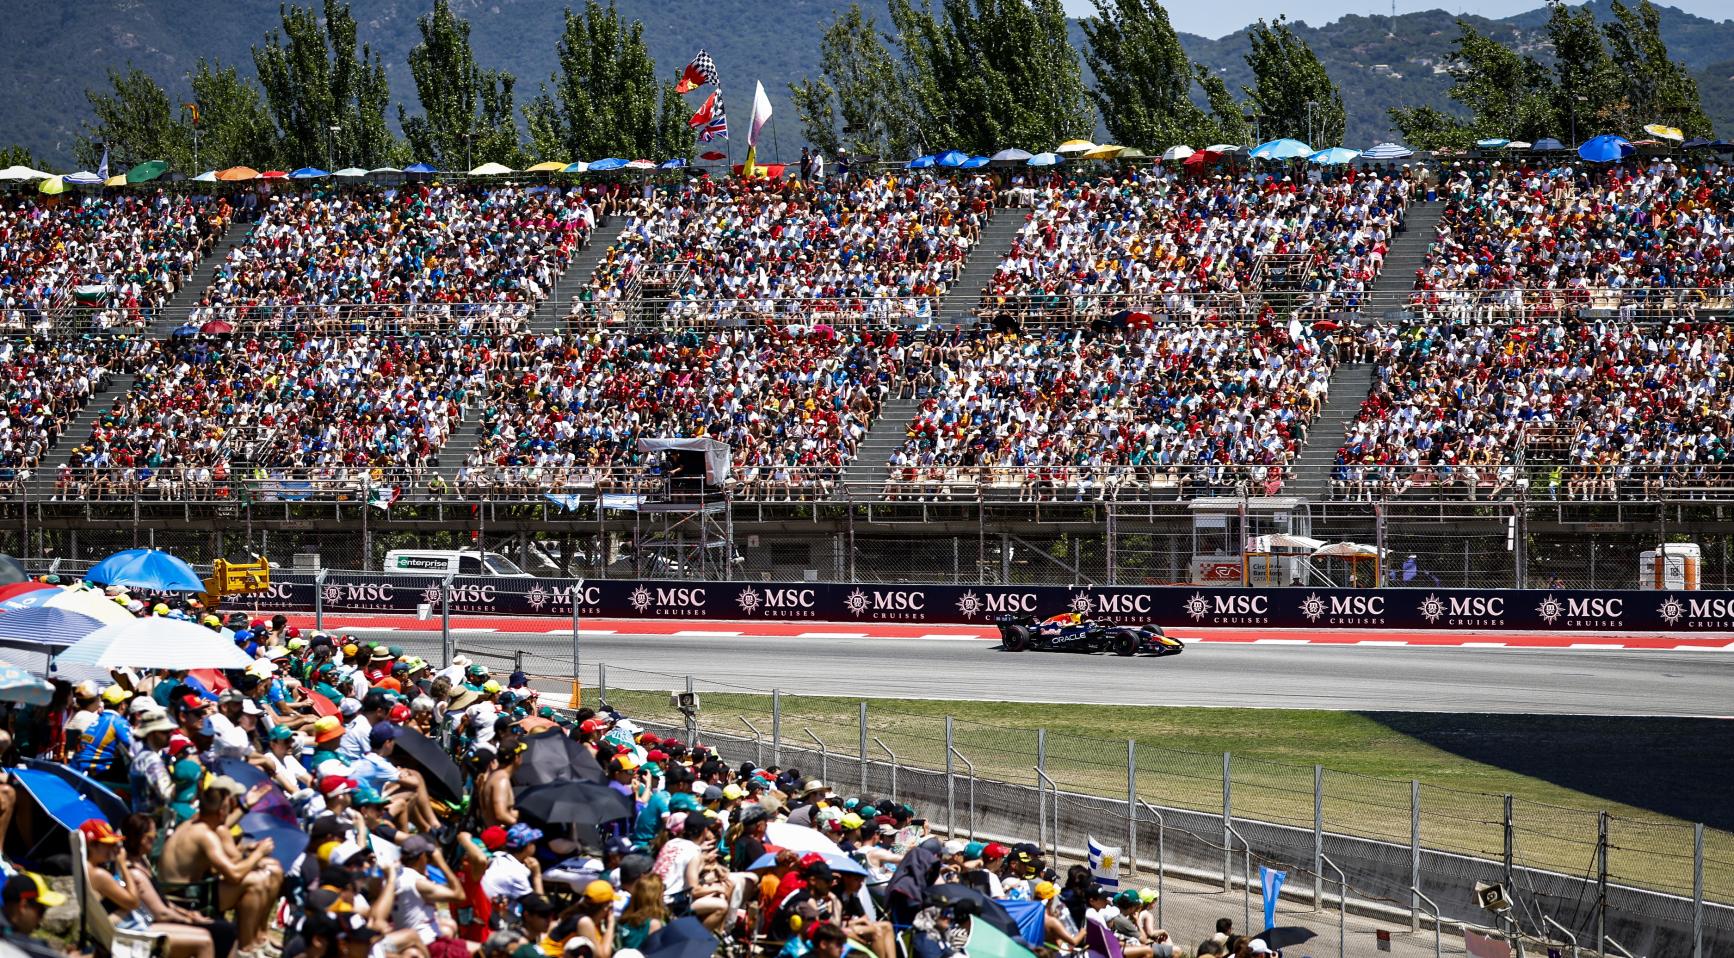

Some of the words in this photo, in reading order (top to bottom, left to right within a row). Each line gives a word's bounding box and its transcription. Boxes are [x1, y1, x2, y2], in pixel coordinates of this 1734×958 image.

[398, 559, 448, 568] enterprise
[347, 583, 393, 601] MSC
[447, 584, 496, 602] MSC
[656, 588, 706, 606] MSC
[764, 589, 815, 607] MSC
[873, 591, 925, 610] MSC
[985, 594, 1037, 612] MSC
[1098, 595, 1151, 613] MSC
[1214, 595, 1268, 614] MSC
[1330, 596, 1385, 615] MSC
[1448, 597, 1504, 616] MSC
[1567, 598, 1623, 617] MSC
[1052, 632, 1086, 644] ORACLE
